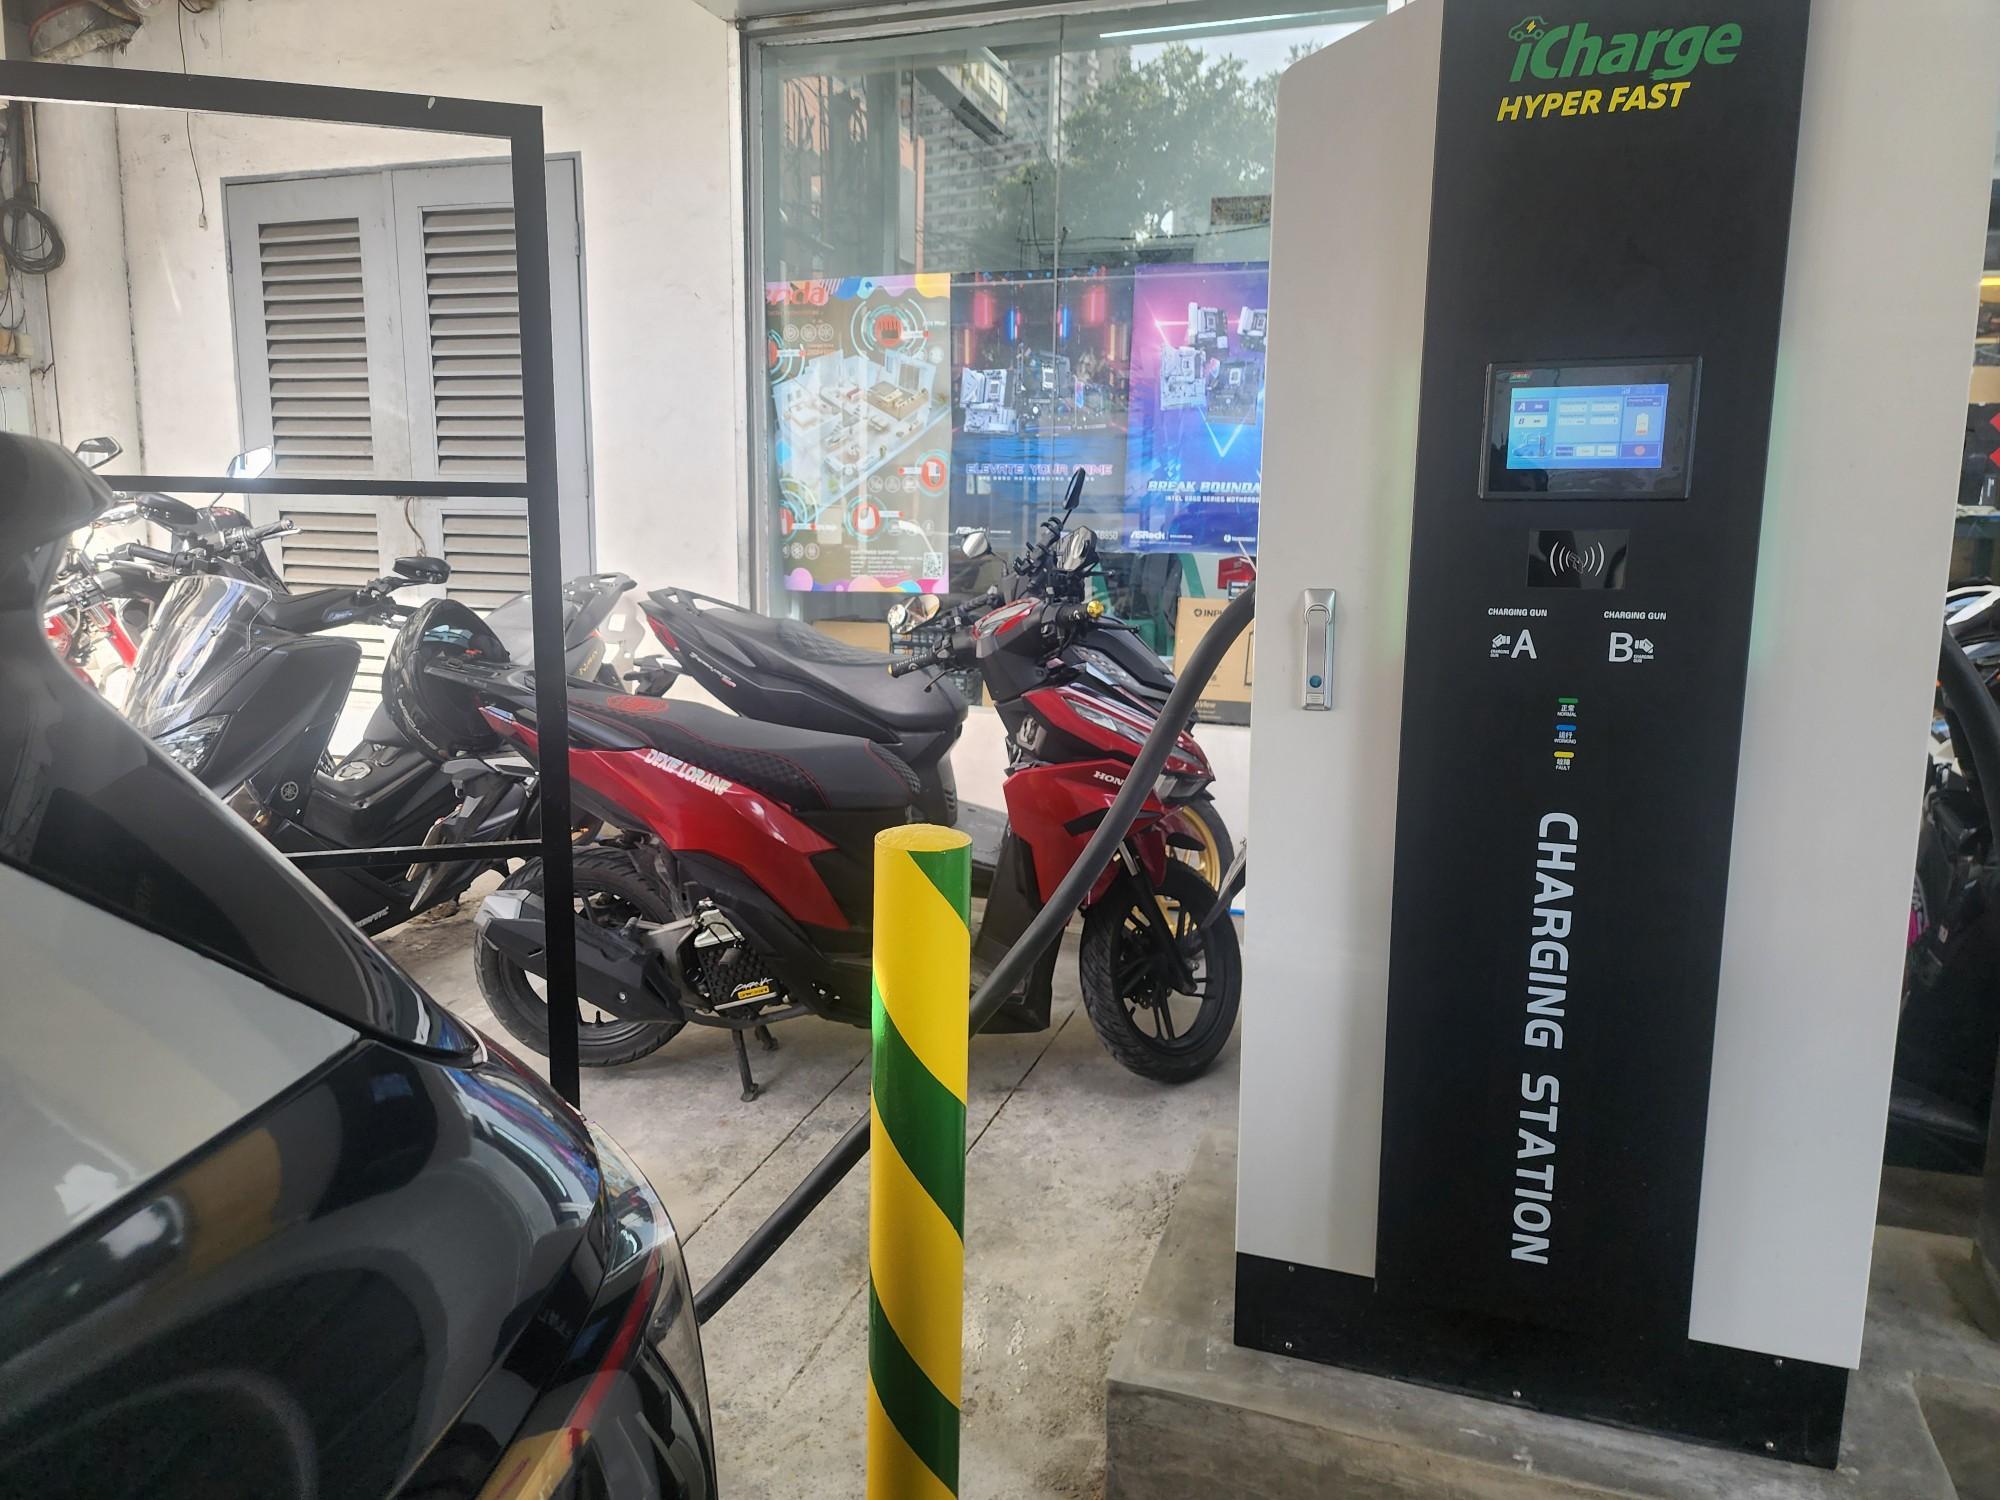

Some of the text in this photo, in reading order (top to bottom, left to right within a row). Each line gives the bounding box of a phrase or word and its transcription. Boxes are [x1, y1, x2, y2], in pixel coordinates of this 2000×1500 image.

[1508, 20, 1743, 82] iCharge
[1496, 81, 1692, 122] HYPER FAST
[965, 462, 1025, 476] ELEVATE
[1029, 463, 1069, 476] YOUR
[1147, 480, 1197, 493] BREAK
[1130, 530, 1165, 540] ASRock
[1487, 607, 1548, 617] CHARGING GUN
[1603, 610, 1667, 621] CHARGING GUN
[1510, 629, 1537, 660] A
[1608, 631, 1634, 663] B
[1093, 770, 1125, 786] HON
[1510, 811, 1579, 1266] CHARGING STATION
